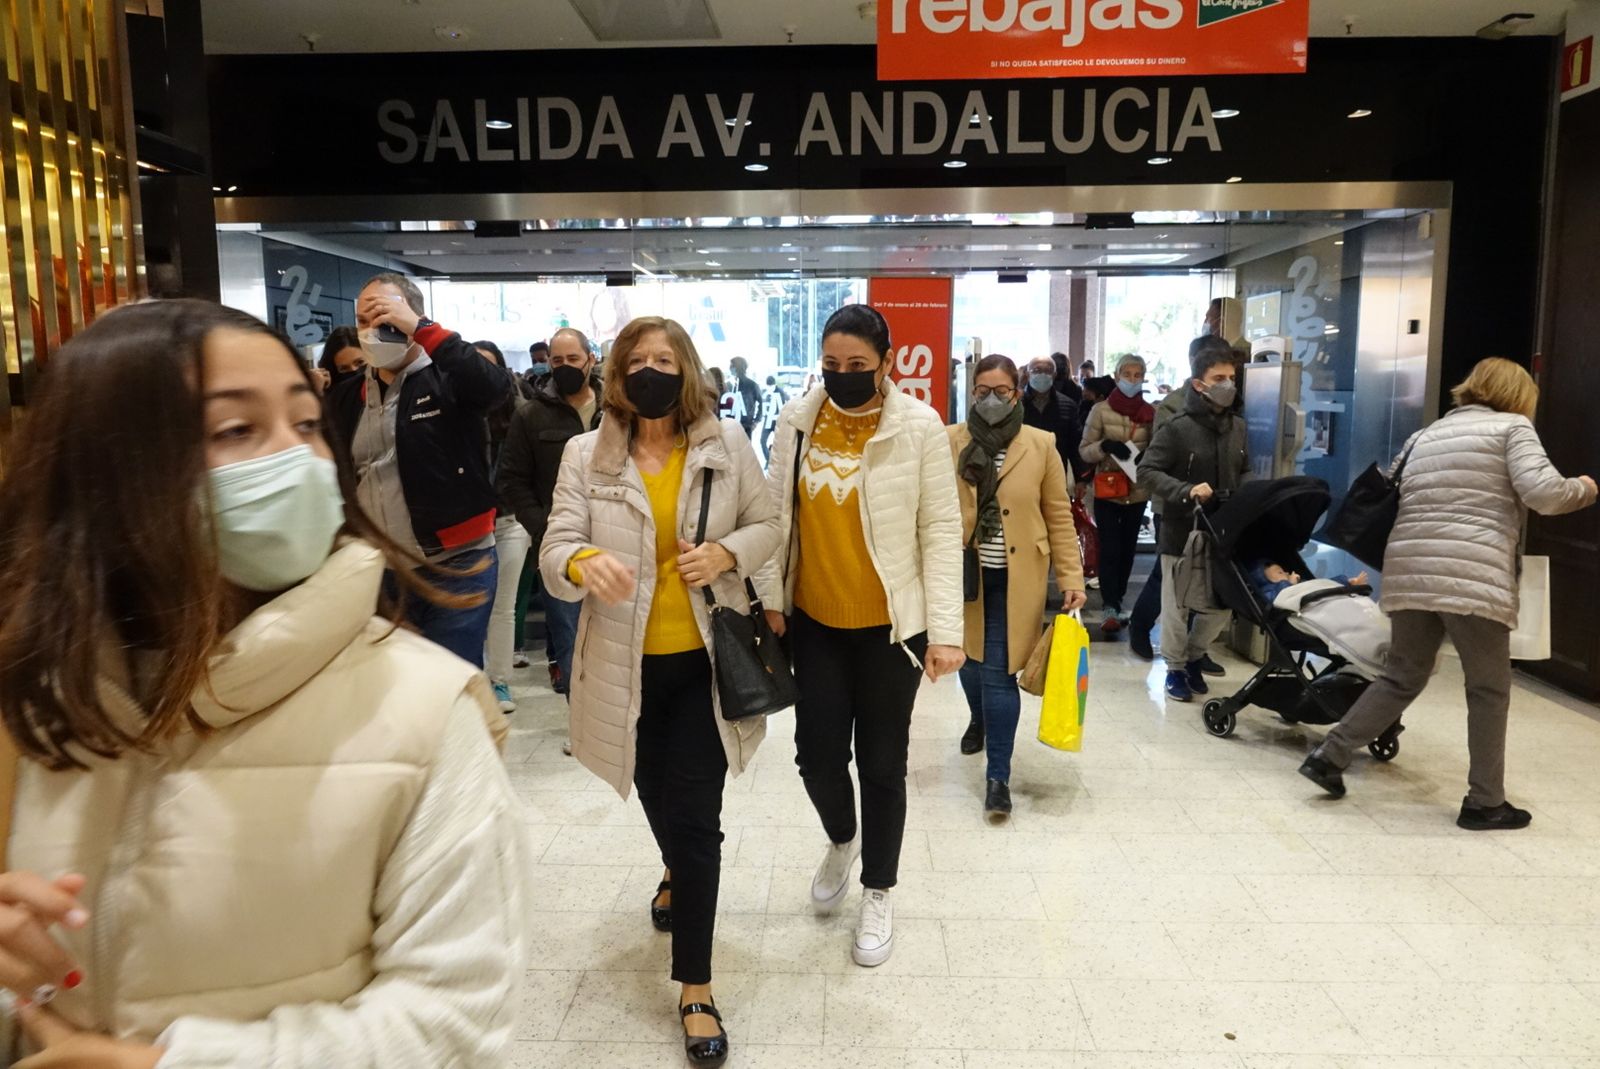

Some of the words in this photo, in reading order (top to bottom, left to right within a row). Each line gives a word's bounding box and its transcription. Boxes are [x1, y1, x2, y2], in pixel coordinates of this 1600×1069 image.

[990, 60, 998, 68] SI
[999, 60, 1010, 68] NO
[1039, 59, 1084, 67] SATISFECHO
[1096, 58, 1145, 66] DEVOLVEMOS
[1158, 57, 1186, 65] DINERO
[376, 95, 634, 164] SALIDA
[656, 92, 771, 158] AV.
[793, 86, 1223, 156] ANDALUCIA
